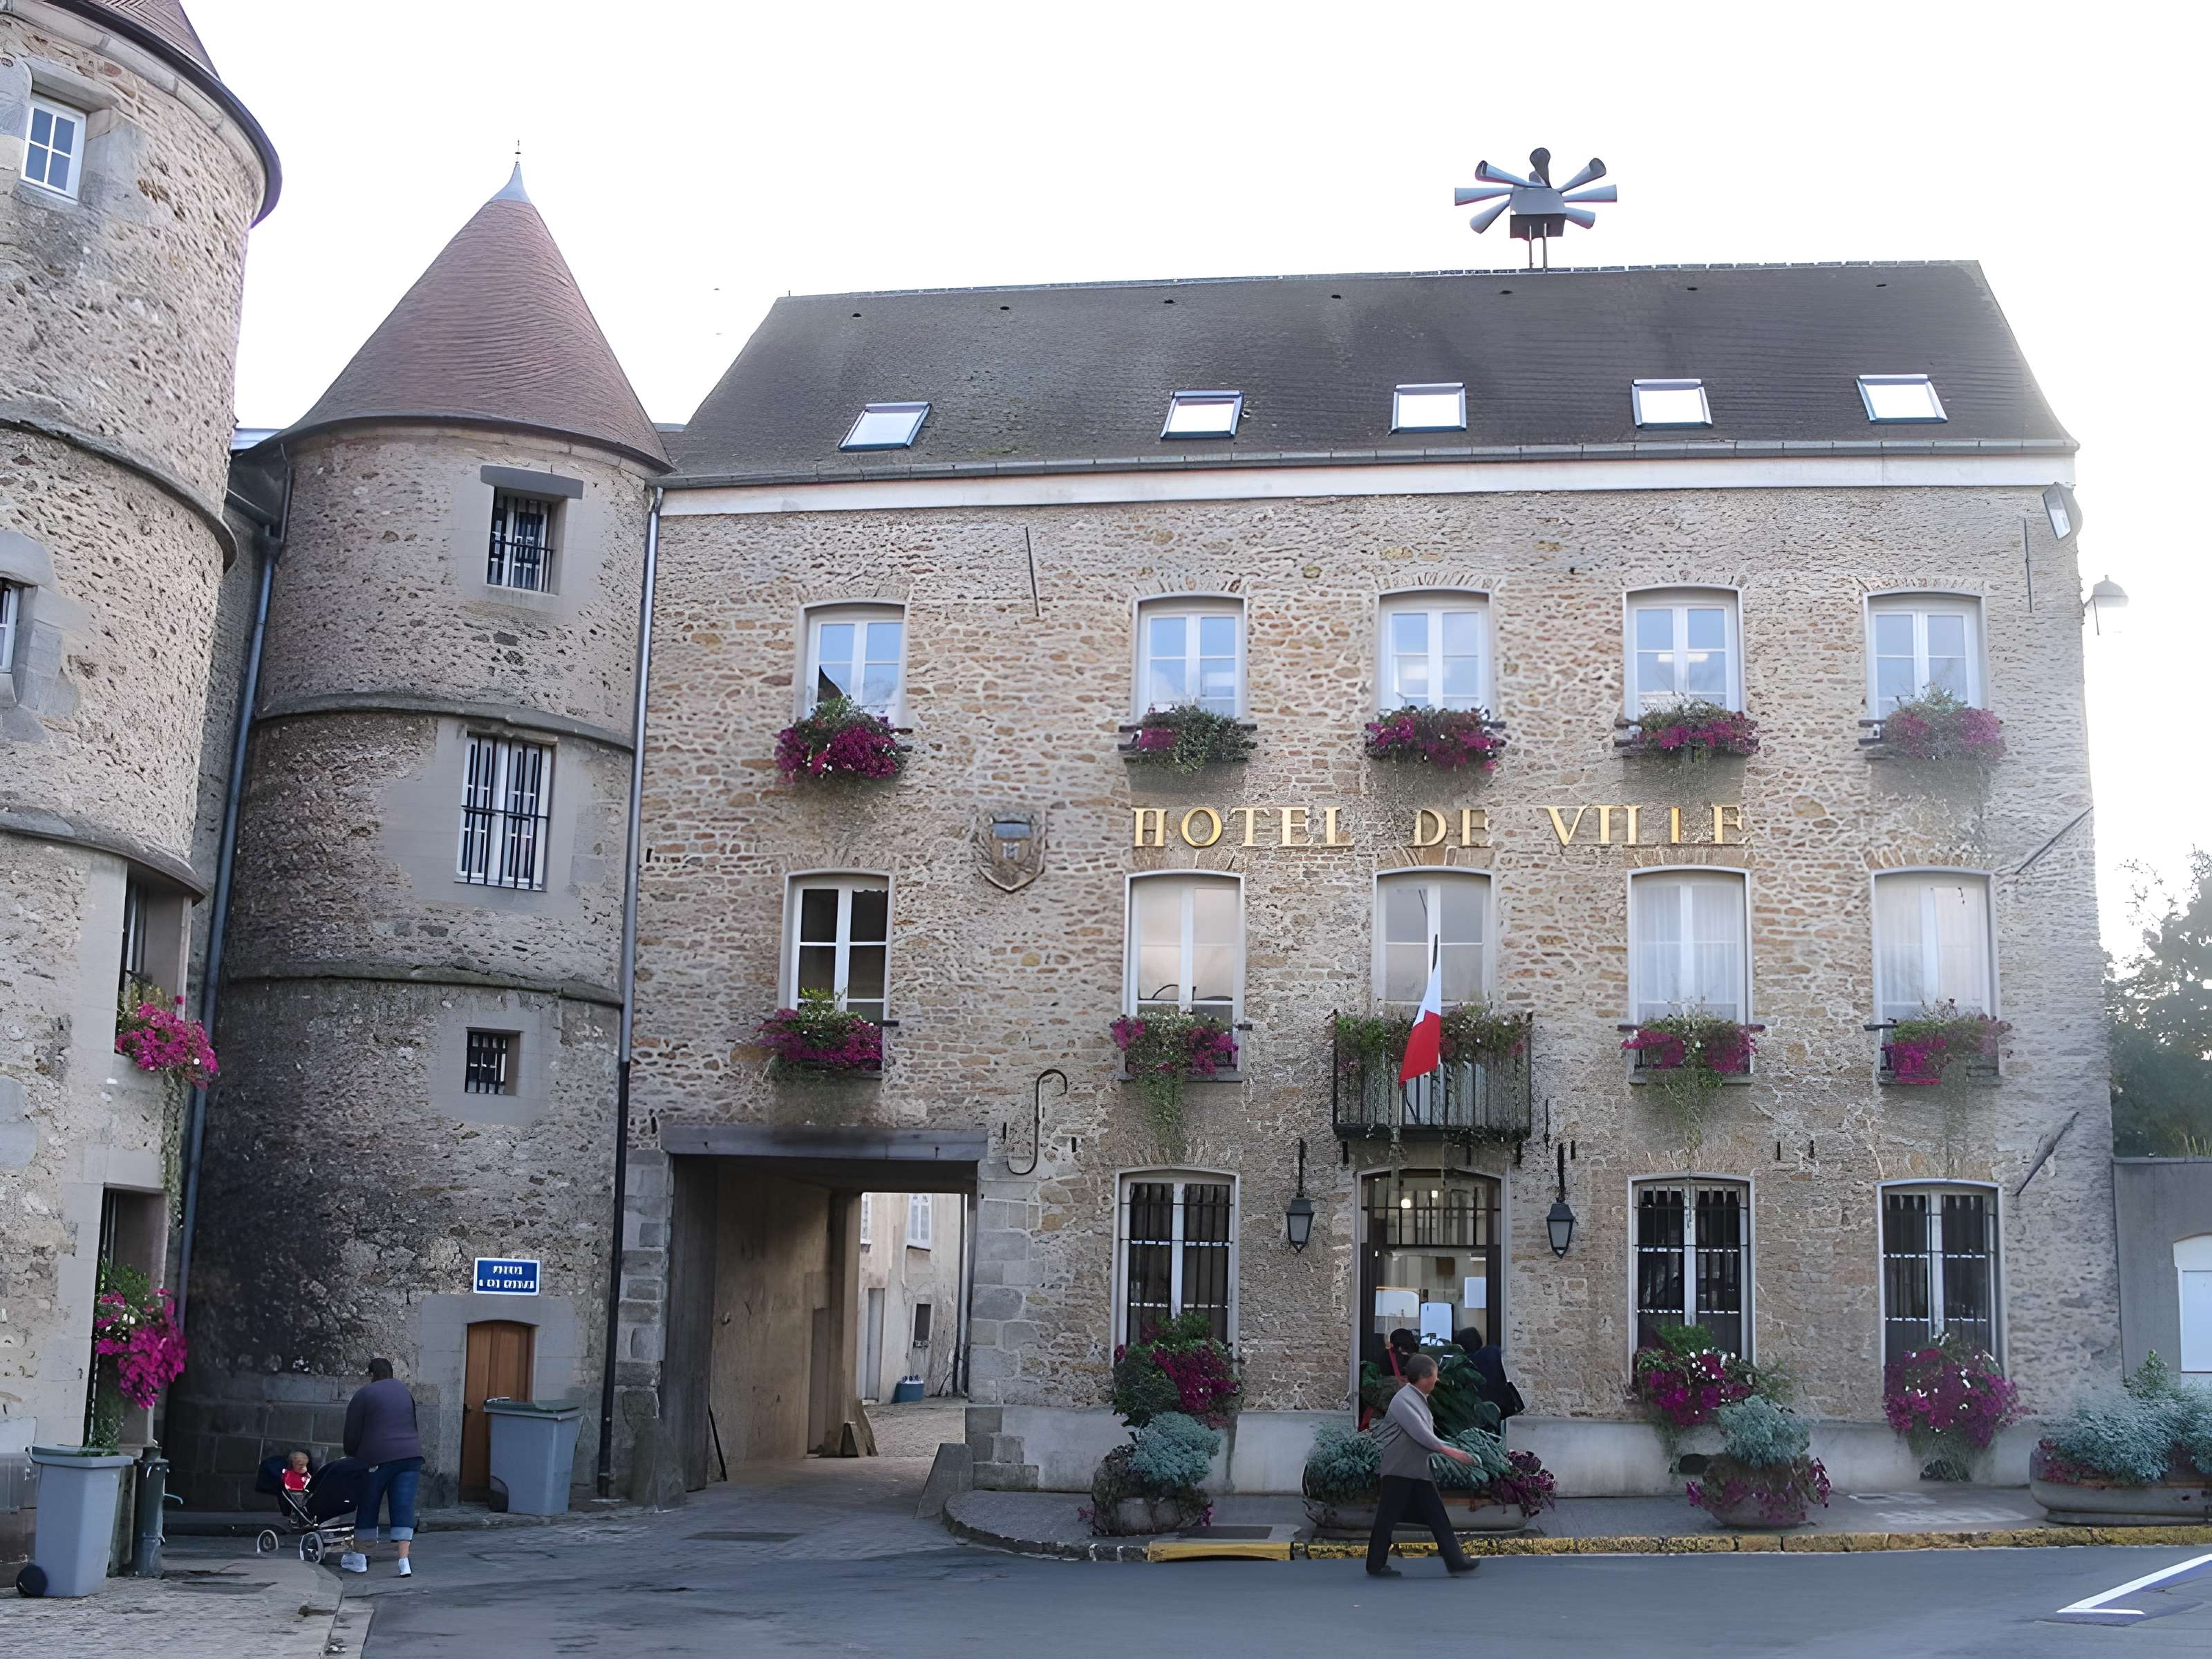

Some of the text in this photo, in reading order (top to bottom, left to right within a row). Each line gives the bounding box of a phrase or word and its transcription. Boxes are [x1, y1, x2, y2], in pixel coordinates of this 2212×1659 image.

[1132, 804, 1745, 847] HOTEL DE VILLE
